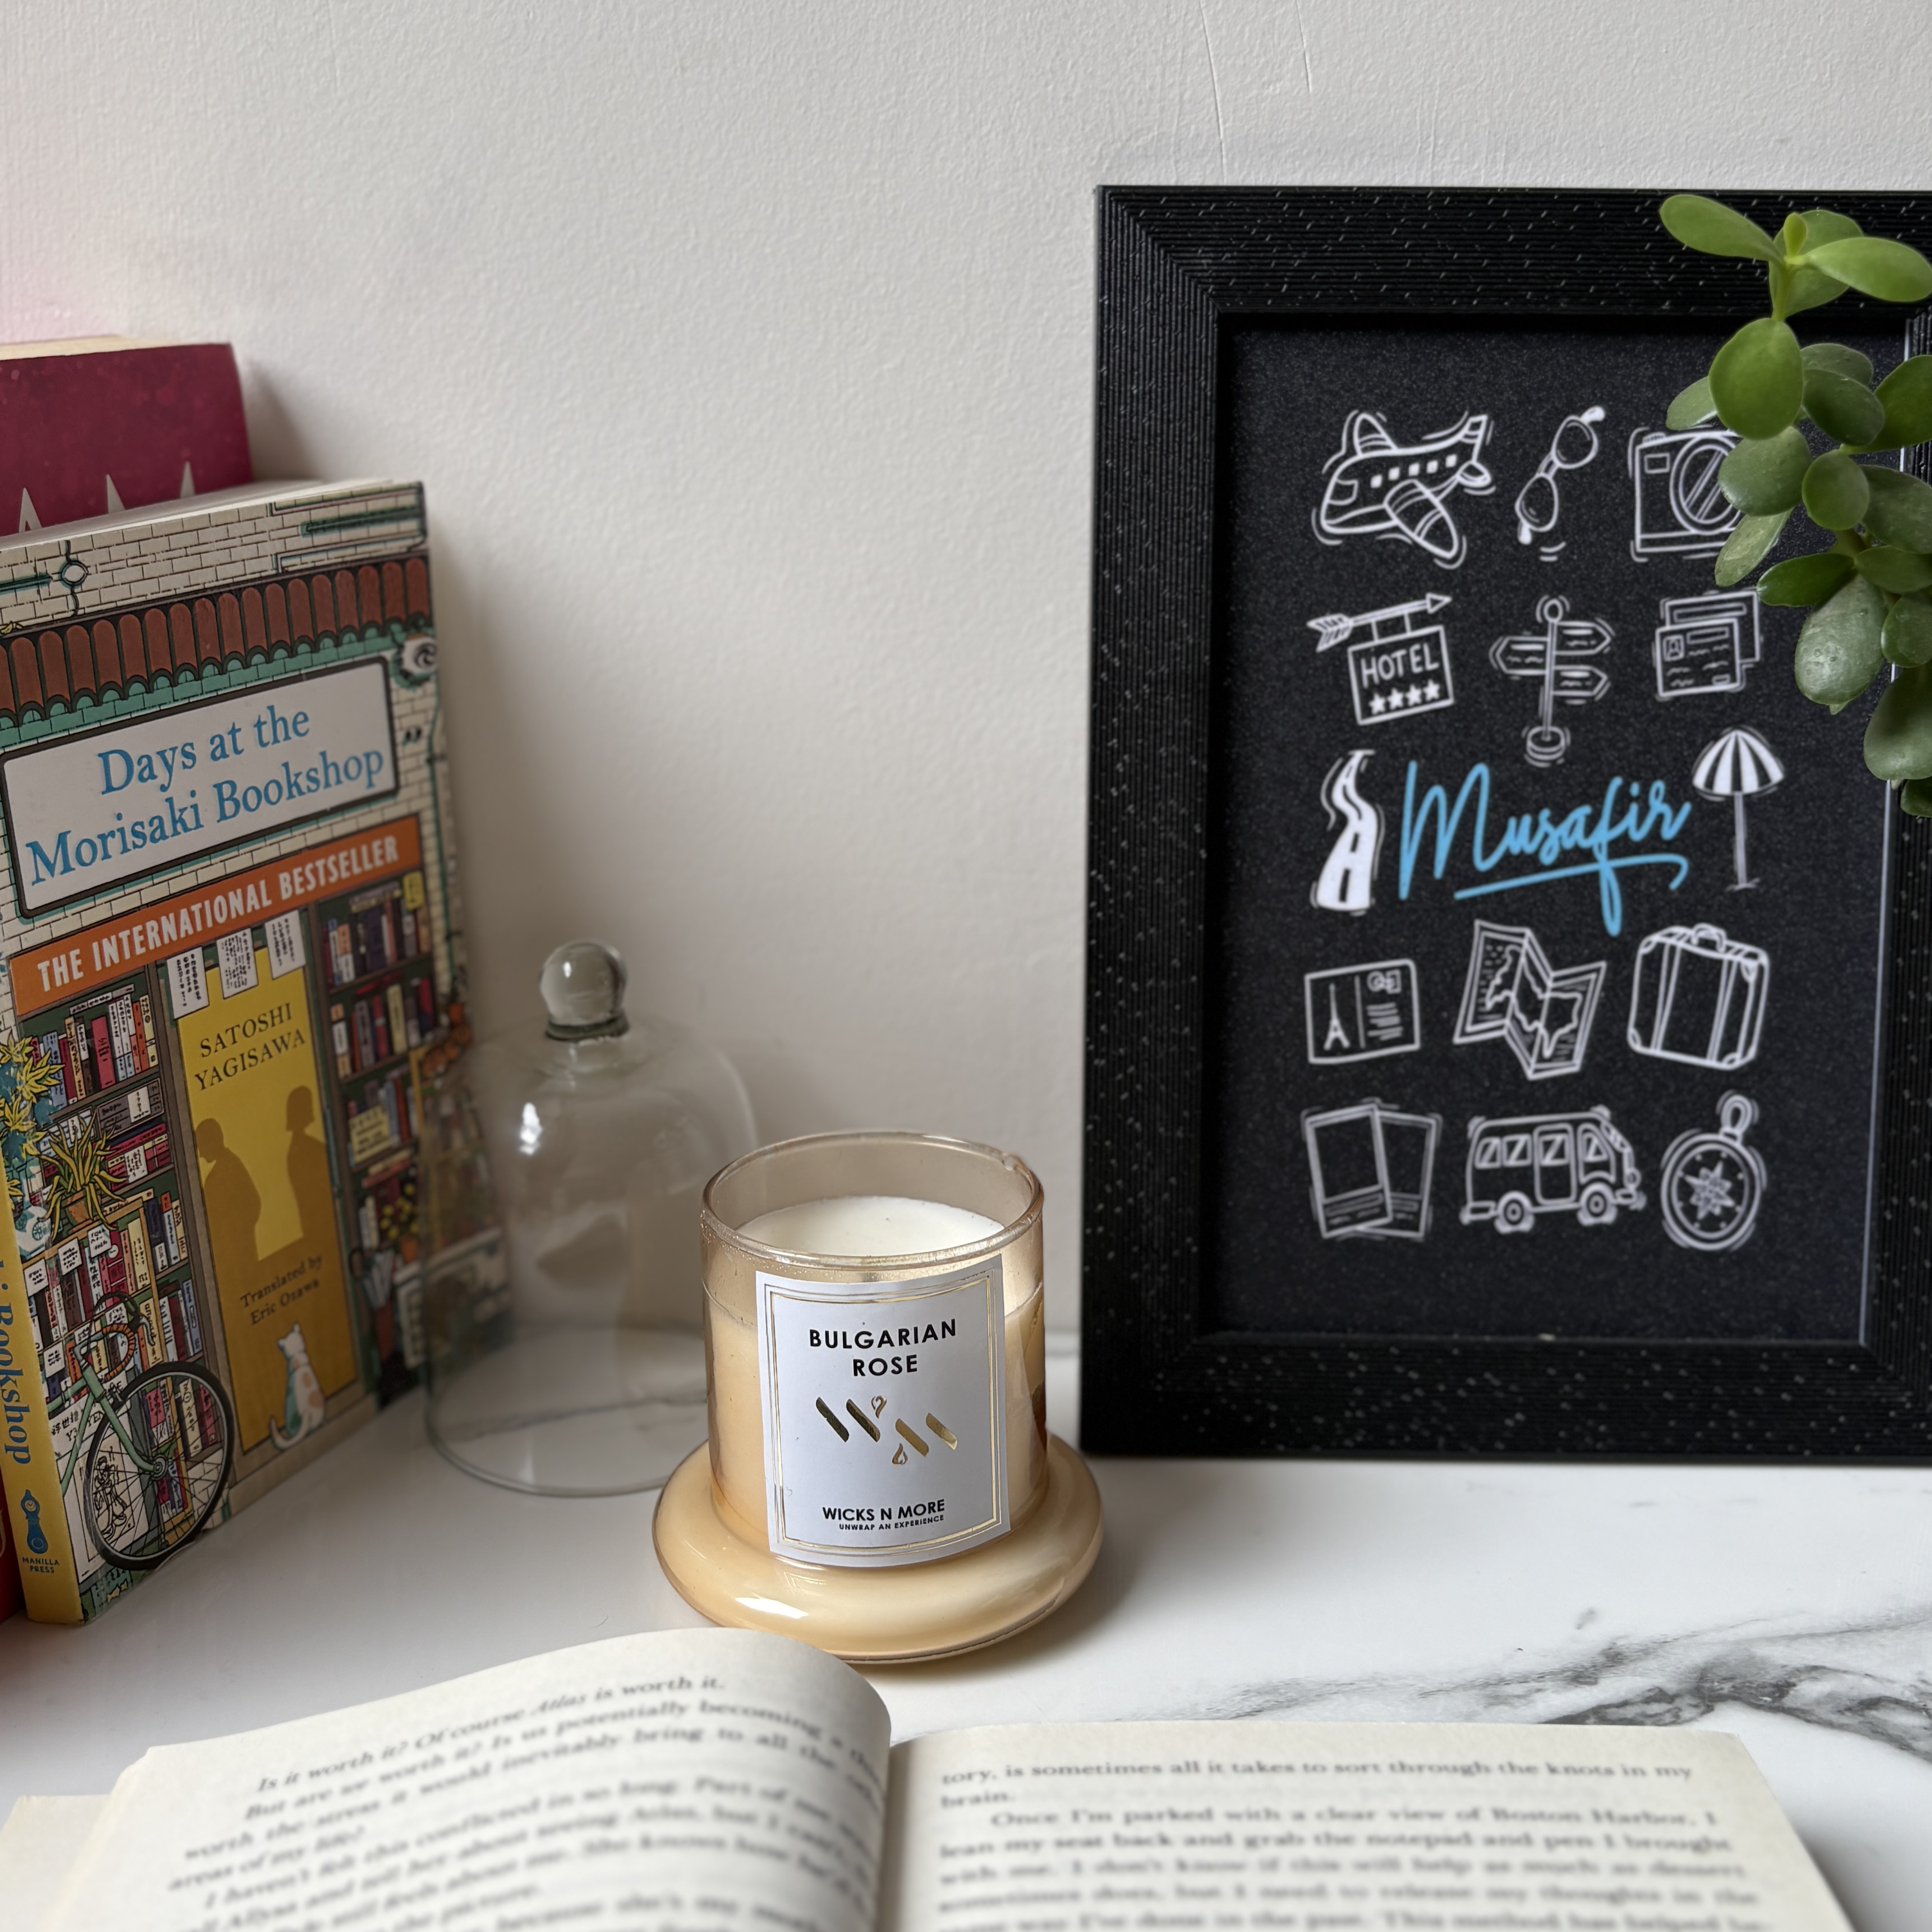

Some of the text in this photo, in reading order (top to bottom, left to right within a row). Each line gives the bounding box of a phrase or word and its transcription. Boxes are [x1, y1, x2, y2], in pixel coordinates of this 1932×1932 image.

[1360, 643, 1439, 688] HOTEL
[97, 704, 310, 795] Days at the
[26, 749, 383, 886] Morisaki Bookshop
[1399, 760, 1691, 936] Musafir
[37, 947, 84, 992] THE
[92, 879, 272, 973] INTERNATIONAL
[278, 835, 399, 901] BESTSELLER
[200, 1003, 292, 1058] SATOSHI
[194, 1028, 306, 1091] YAGISAWA
[240, 1253, 323, 1308] Translated by
[250, 1279, 320, 1324] Eric Ozawa
[810, 1319, 956, 1349] BULGARIAN
[853, 1354, 918, 1376] ROSE
[823, 1499, 945, 1522] WICKS N MORE
[894, 1515, 944, 1529] EXPERIENCE
[23, 1557, 59, 1566] MANILLA
[30, 1565, 54, 1573] PRESS
[257, 1676, 726, 1793] Is it worth it? Of course Atlas is worth it.
[941, 1760, 1693, 1785] tory, is sometimes all it takes to sort through the knots in my
[939, 1792, 1015, 1809] brain.
